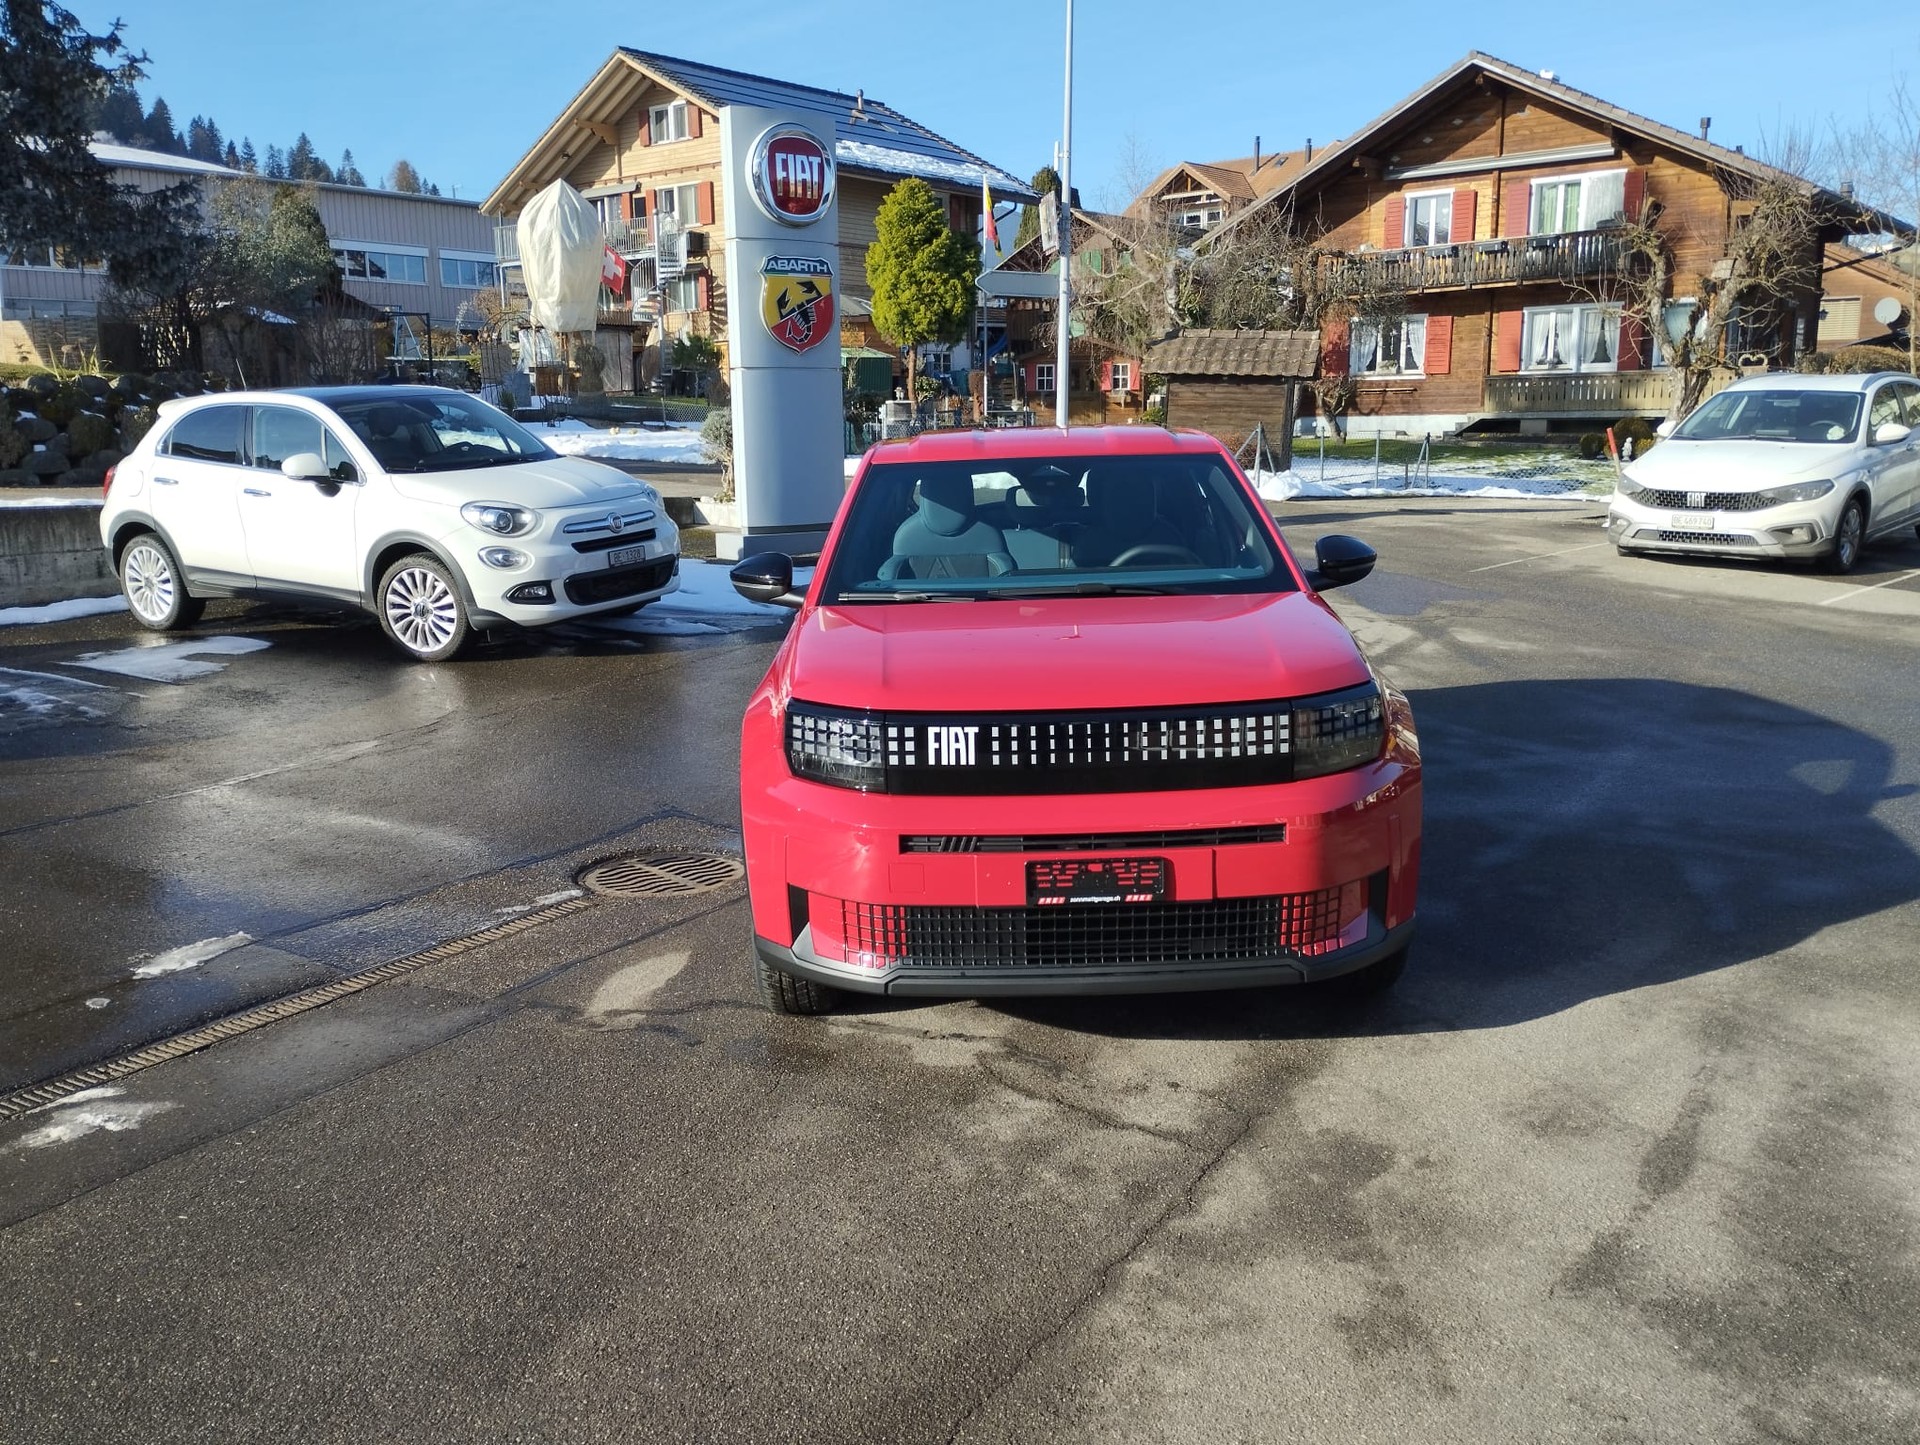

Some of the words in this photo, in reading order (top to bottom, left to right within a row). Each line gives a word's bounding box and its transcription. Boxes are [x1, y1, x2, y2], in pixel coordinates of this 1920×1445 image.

[775, 152, 821, 200] FIAT
[767, 259, 827, 273] ABARTH
[1687, 492, 1707, 507] FIAT
[927, 726, 979, 766] FIAT
